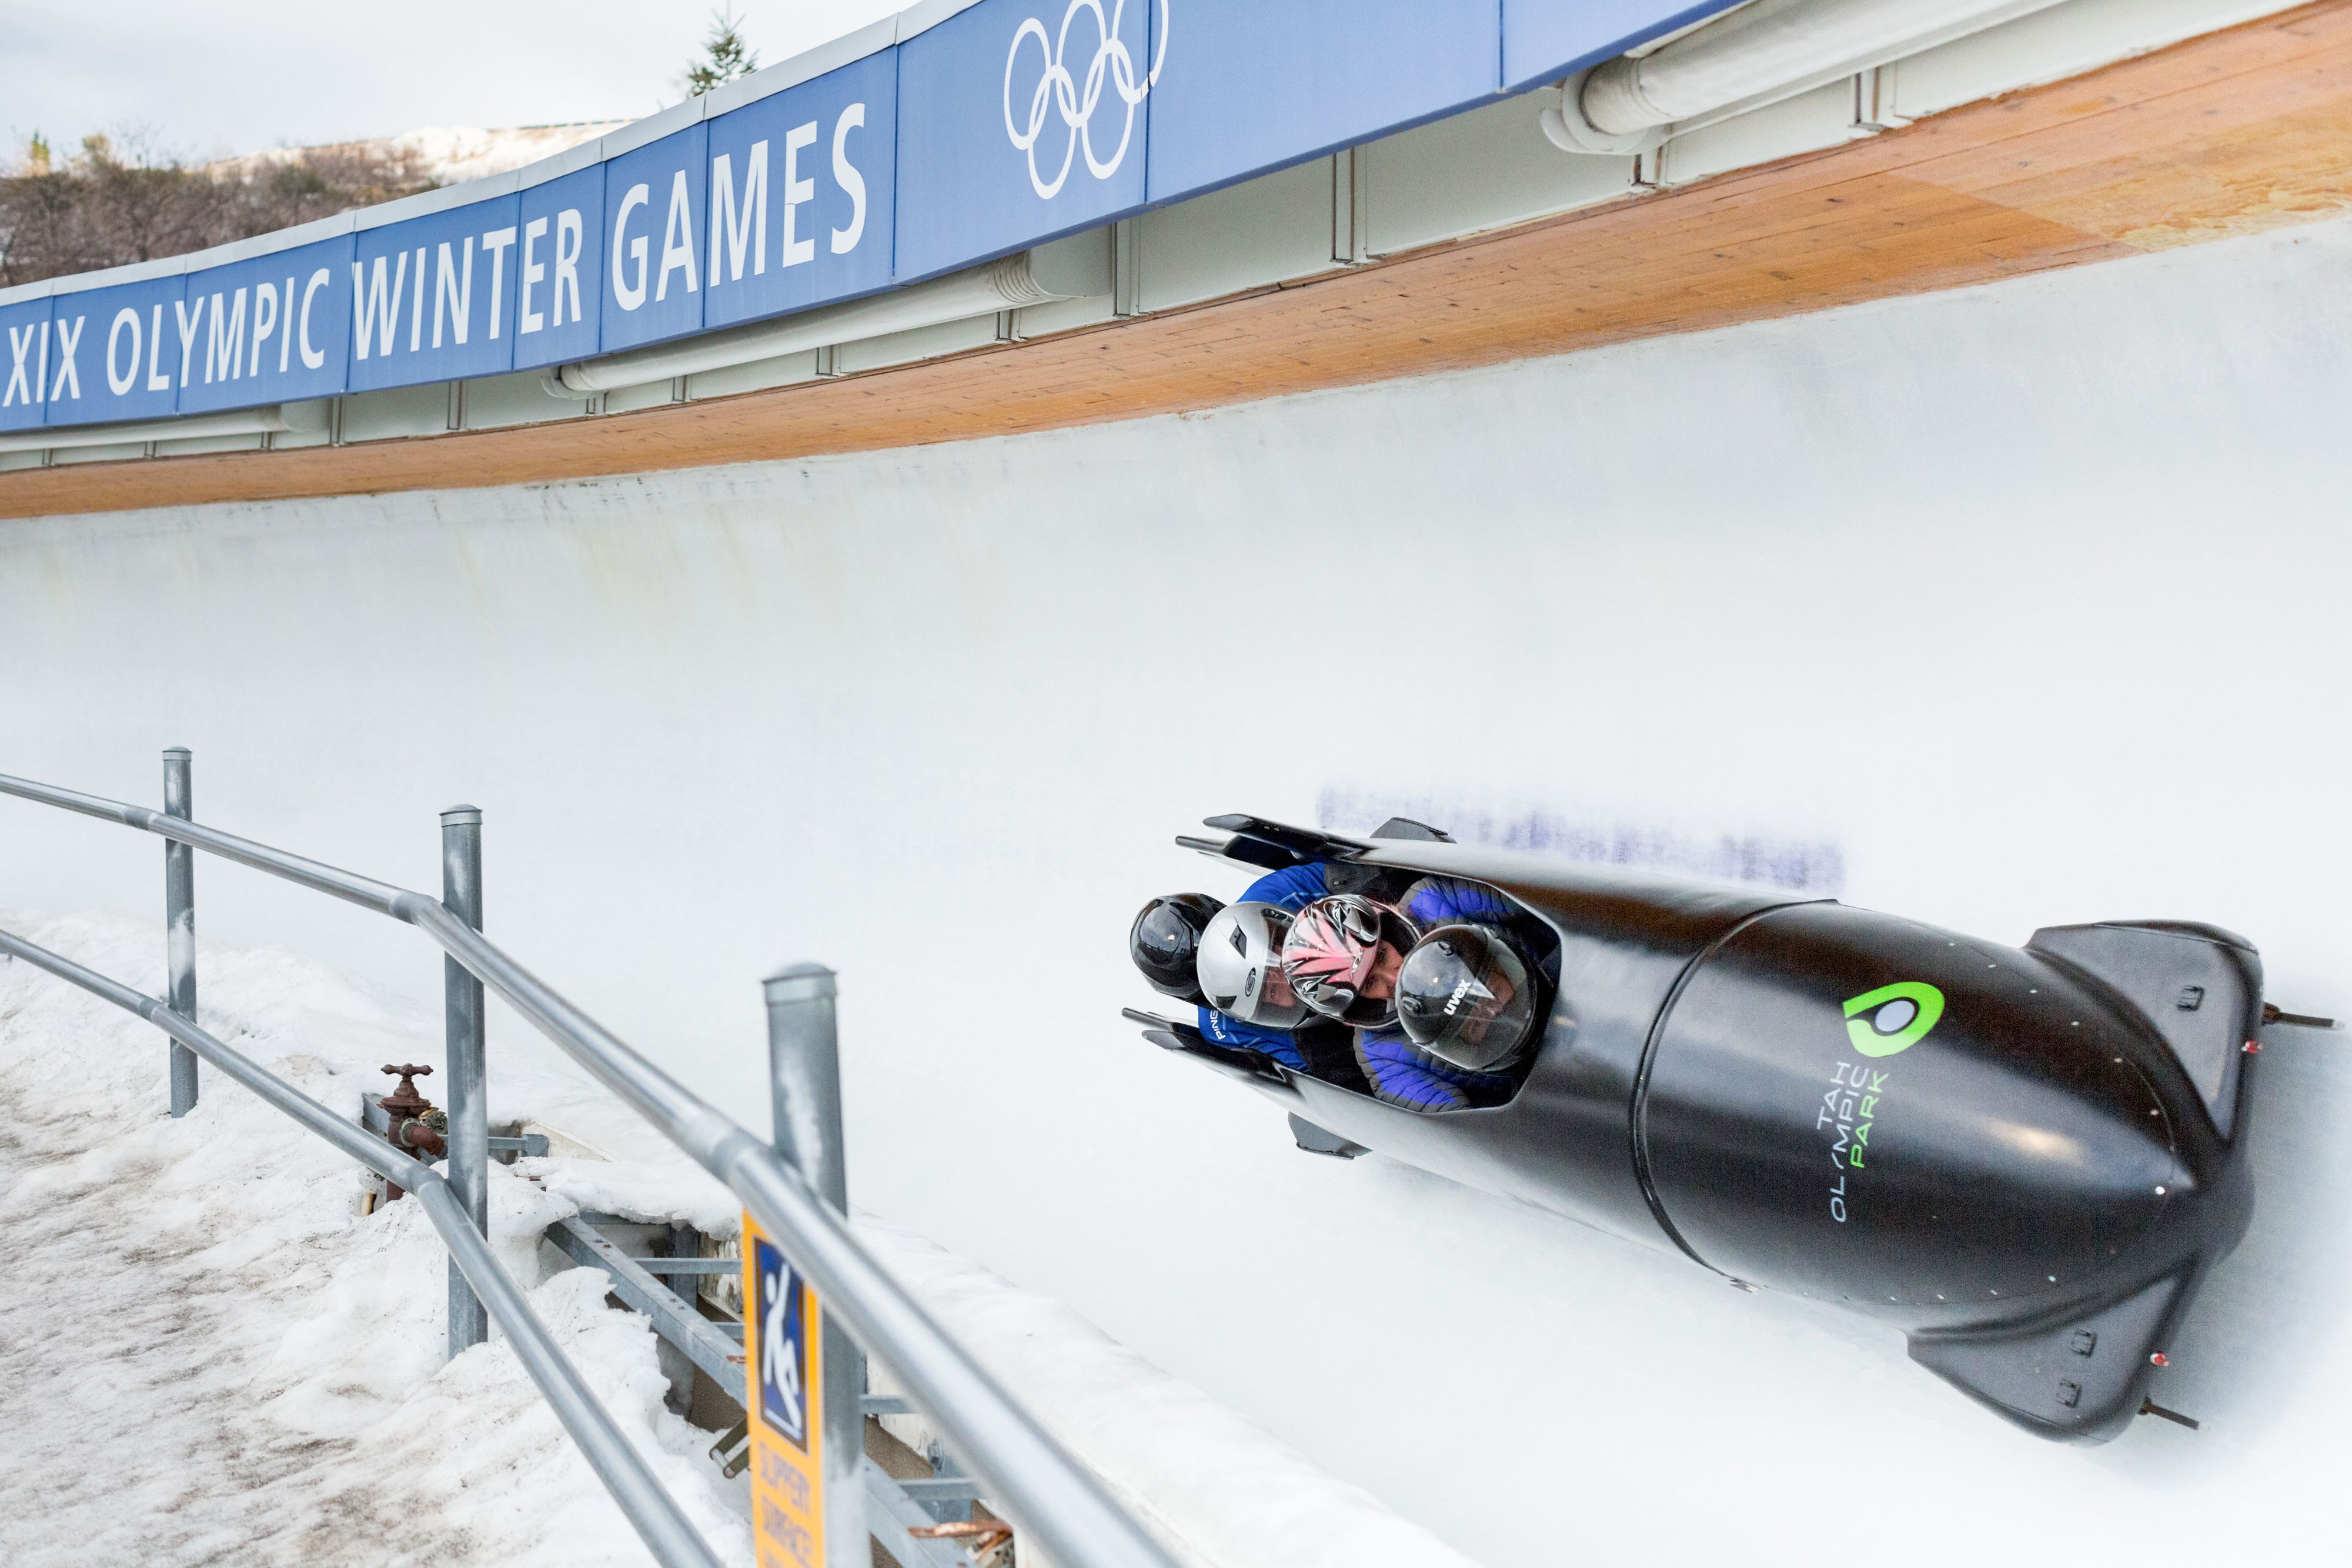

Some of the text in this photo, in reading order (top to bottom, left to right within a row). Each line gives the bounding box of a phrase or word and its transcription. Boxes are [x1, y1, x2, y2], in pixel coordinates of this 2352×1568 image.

[2, 102, 867, 407] XIX OLYMPIC WINTER GAMES
[1444, 979, 1471, 1015] uvex
[1850, 1070, 1890, 1168] PARK
